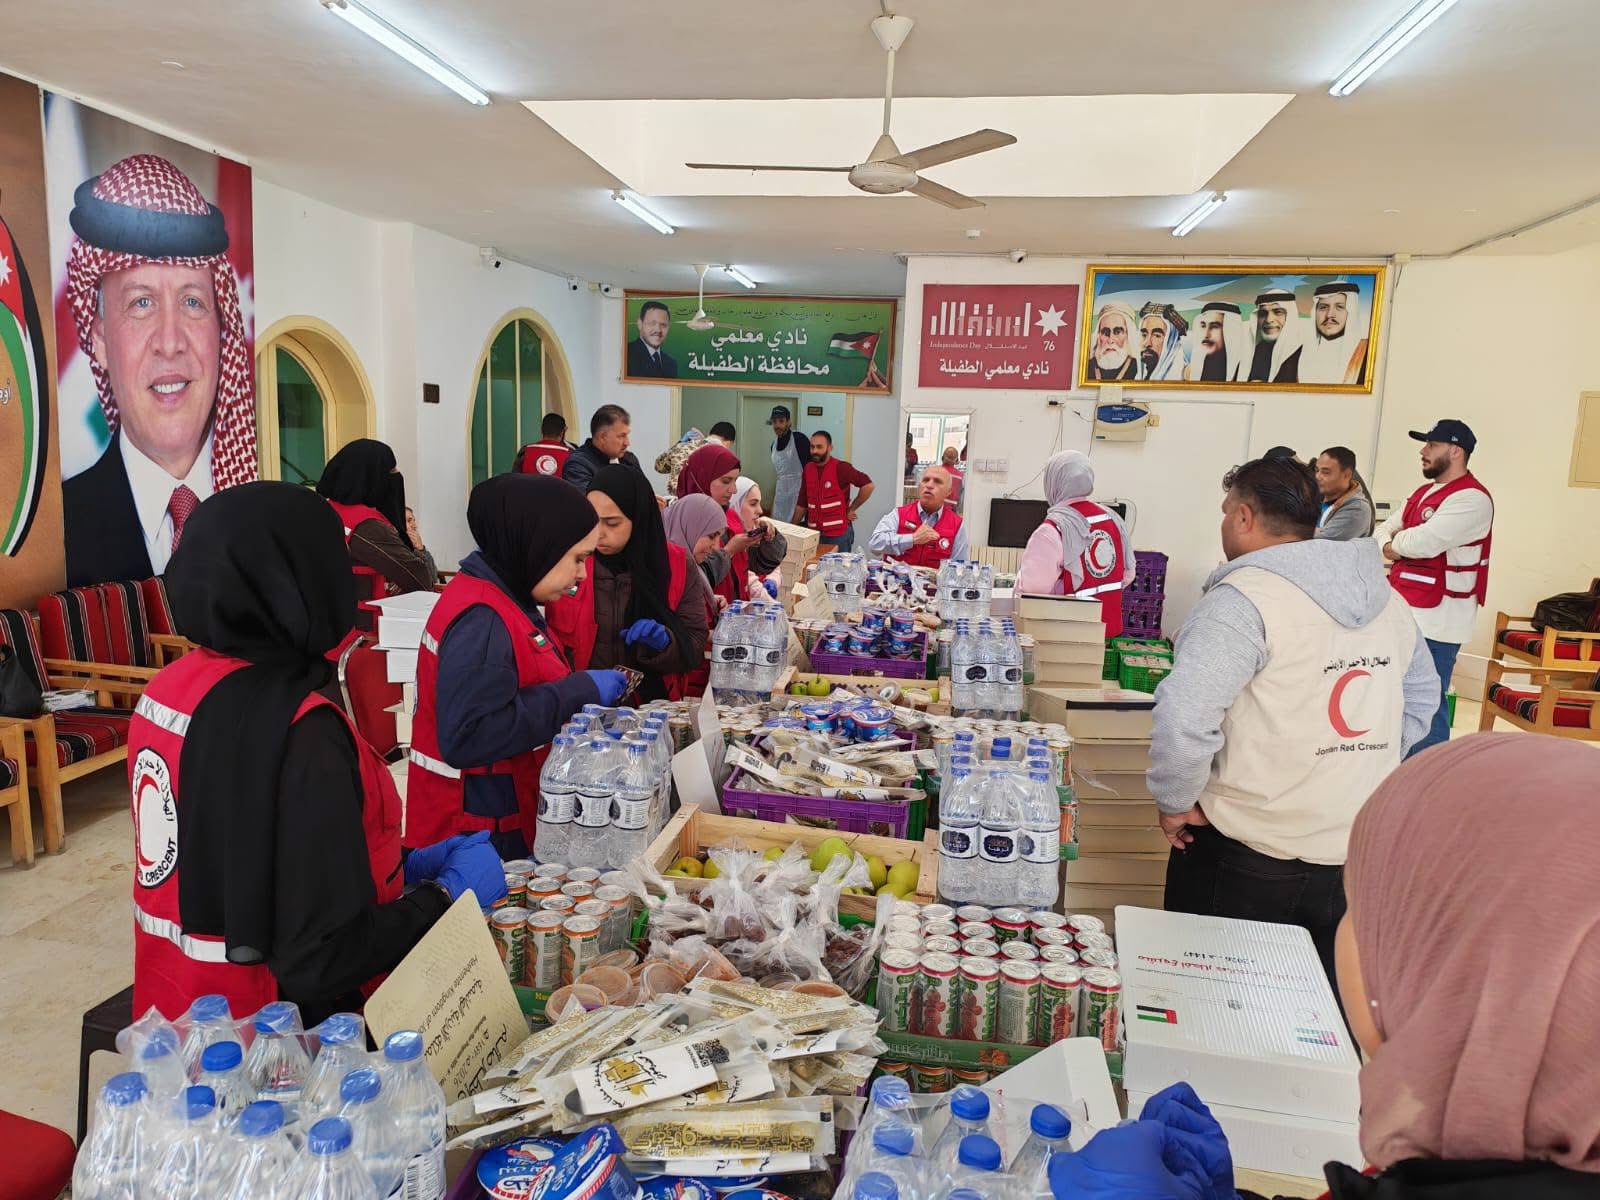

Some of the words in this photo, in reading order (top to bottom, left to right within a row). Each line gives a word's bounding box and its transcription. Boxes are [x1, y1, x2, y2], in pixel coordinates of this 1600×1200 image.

[711, 329, 764, 351] معلمي
[767, 328, 808, 351] نادي
[1043, 341, 1055, 351] 76
[688, 352, 754, 376] الطفيلة
[758, 354, 830, 375] محافظة
[939, 358, 982, 377] الطفيلة
[985, 360, 1020, 380] معلمي
[1022, 360, 1049, 379] نادي
[1340, 744, 1355, 752] Red
[1357, 742, 1389, 751] Crescent
[145, 837, 177, 883] CRESCENT
[454, 954, 478, 988] Hashemite
[431, 986, 454, 1017] Kingdom
